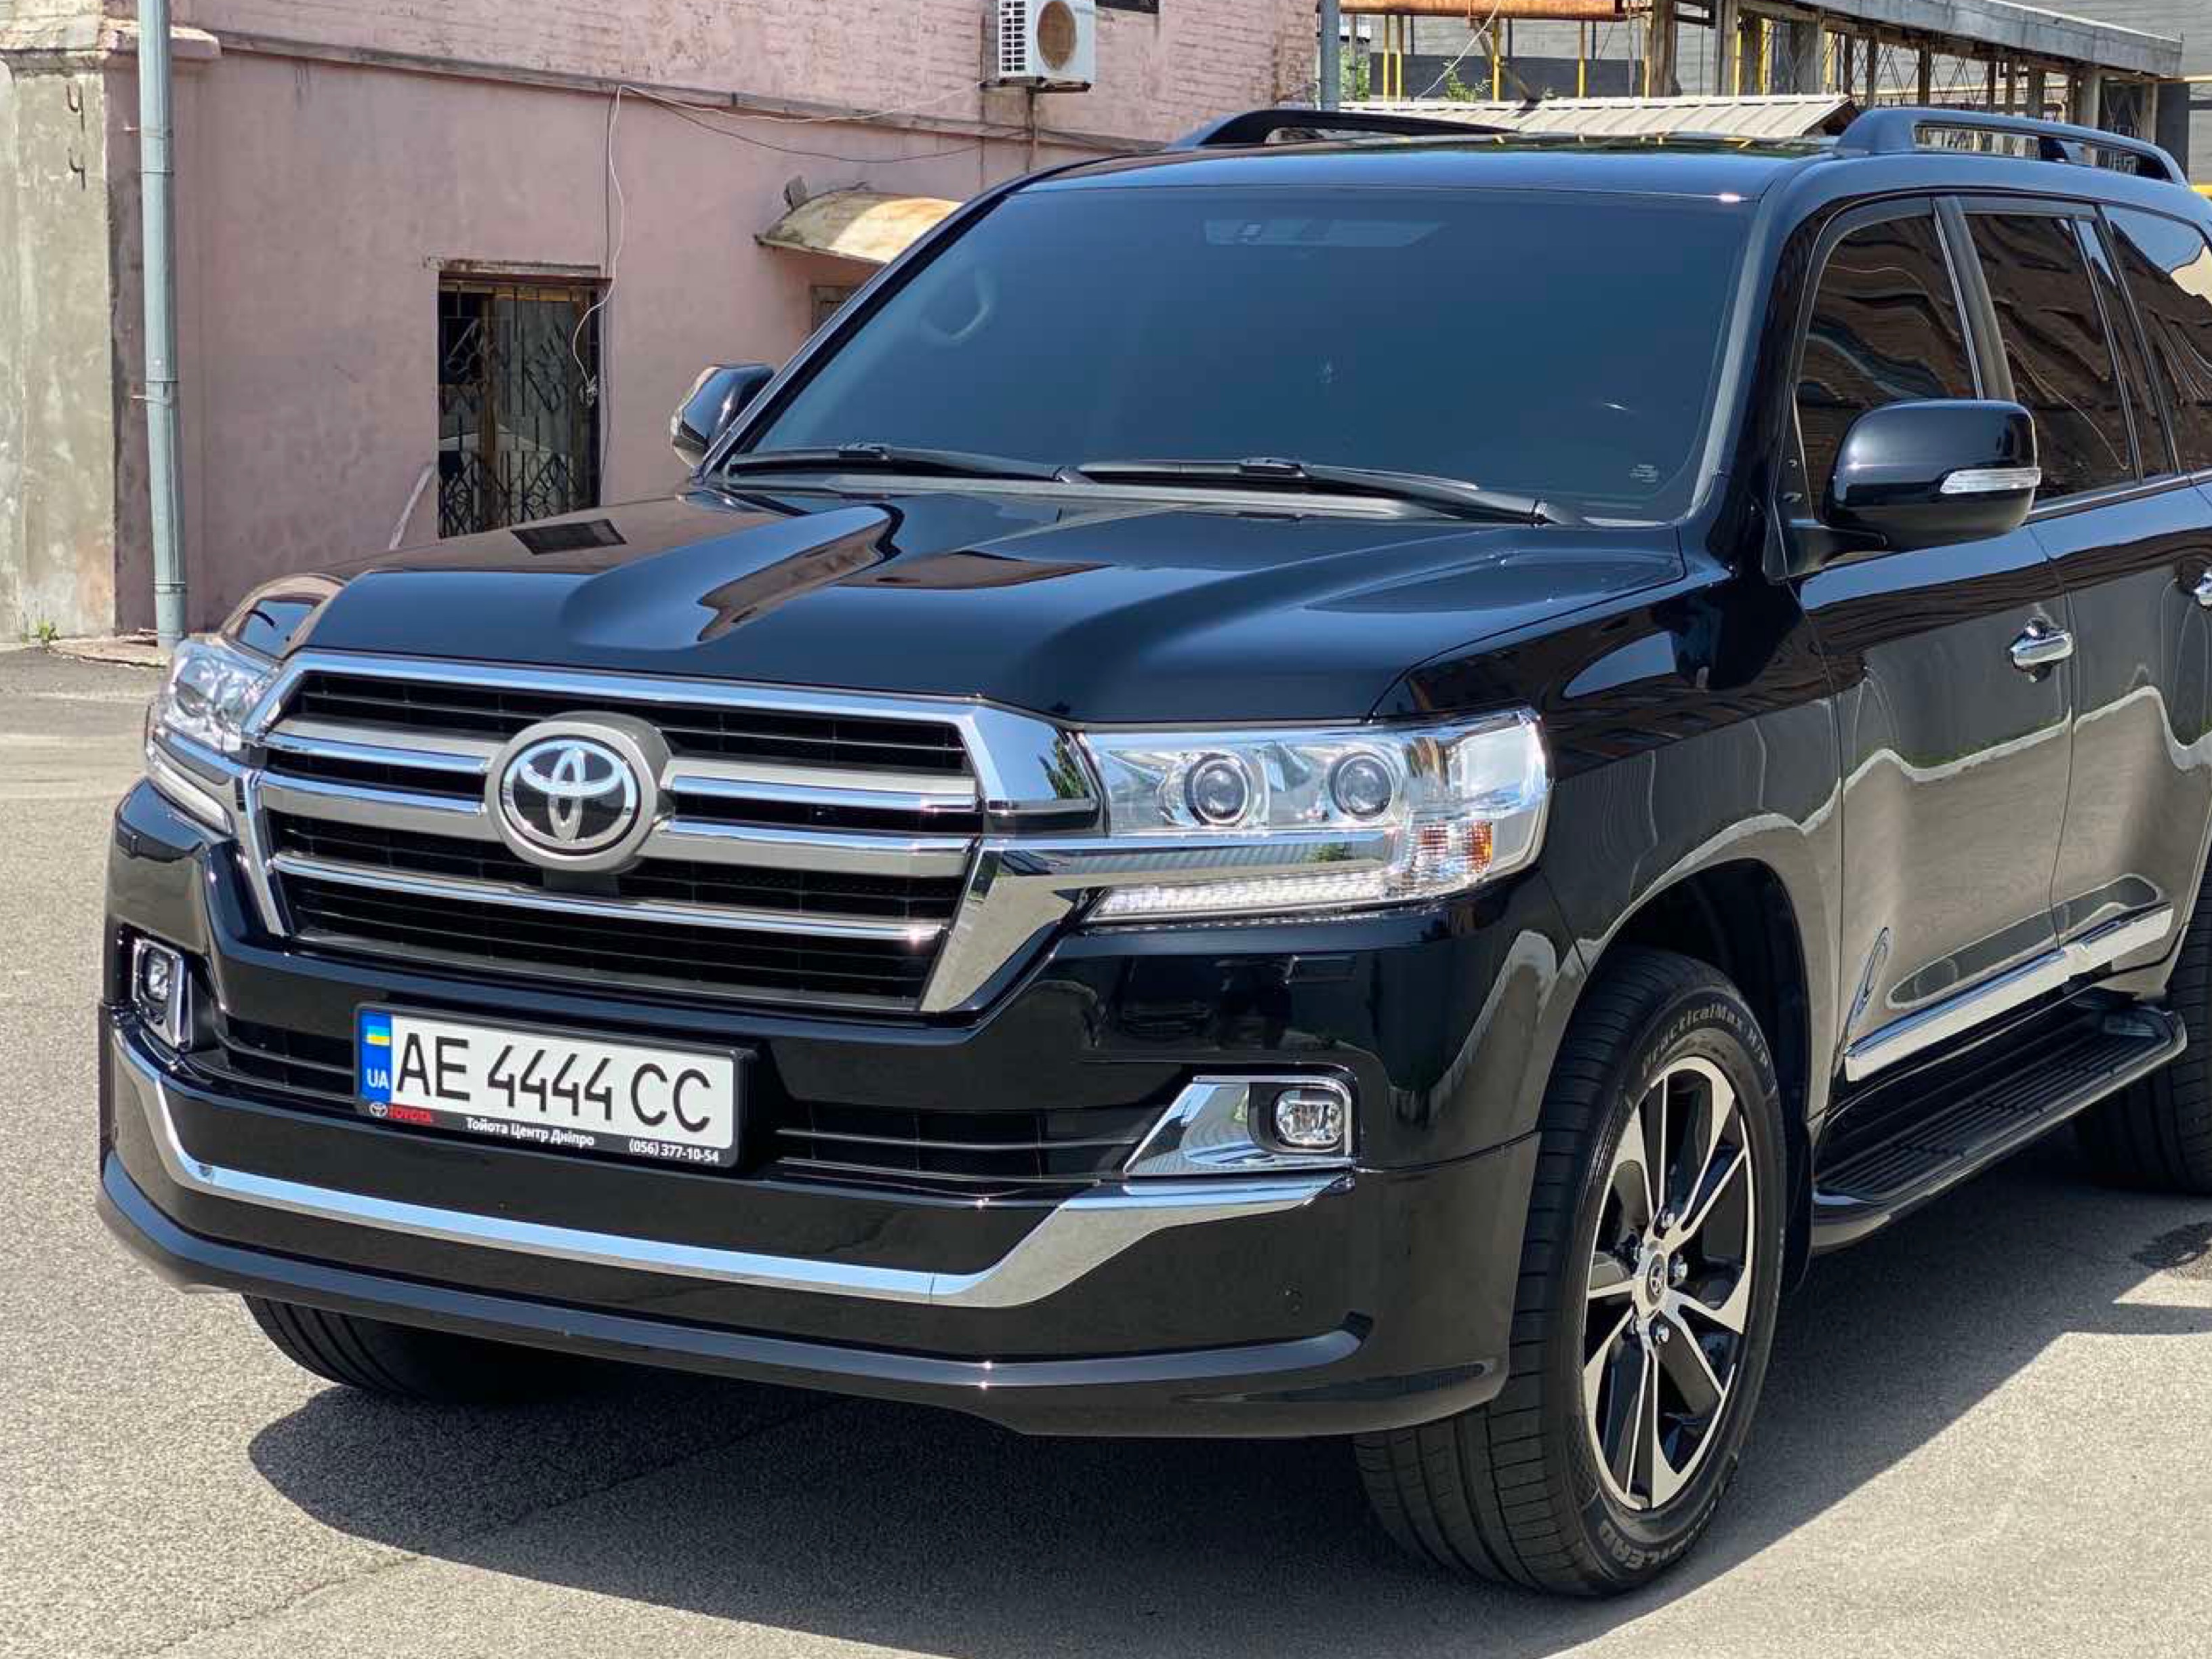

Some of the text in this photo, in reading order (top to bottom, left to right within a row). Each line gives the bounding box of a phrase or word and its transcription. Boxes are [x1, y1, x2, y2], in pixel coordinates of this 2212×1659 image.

[367, 1068, 390, 1090] UA
[396, 1032, 712, 1132] AE 4444 CC
[388, 1105, 431, 1124] TOYOTA
[466, 1117, 595, 1147] Тойота Центр Дніпро
[629, 1138, 719, 1163] (056) 377-10-54
